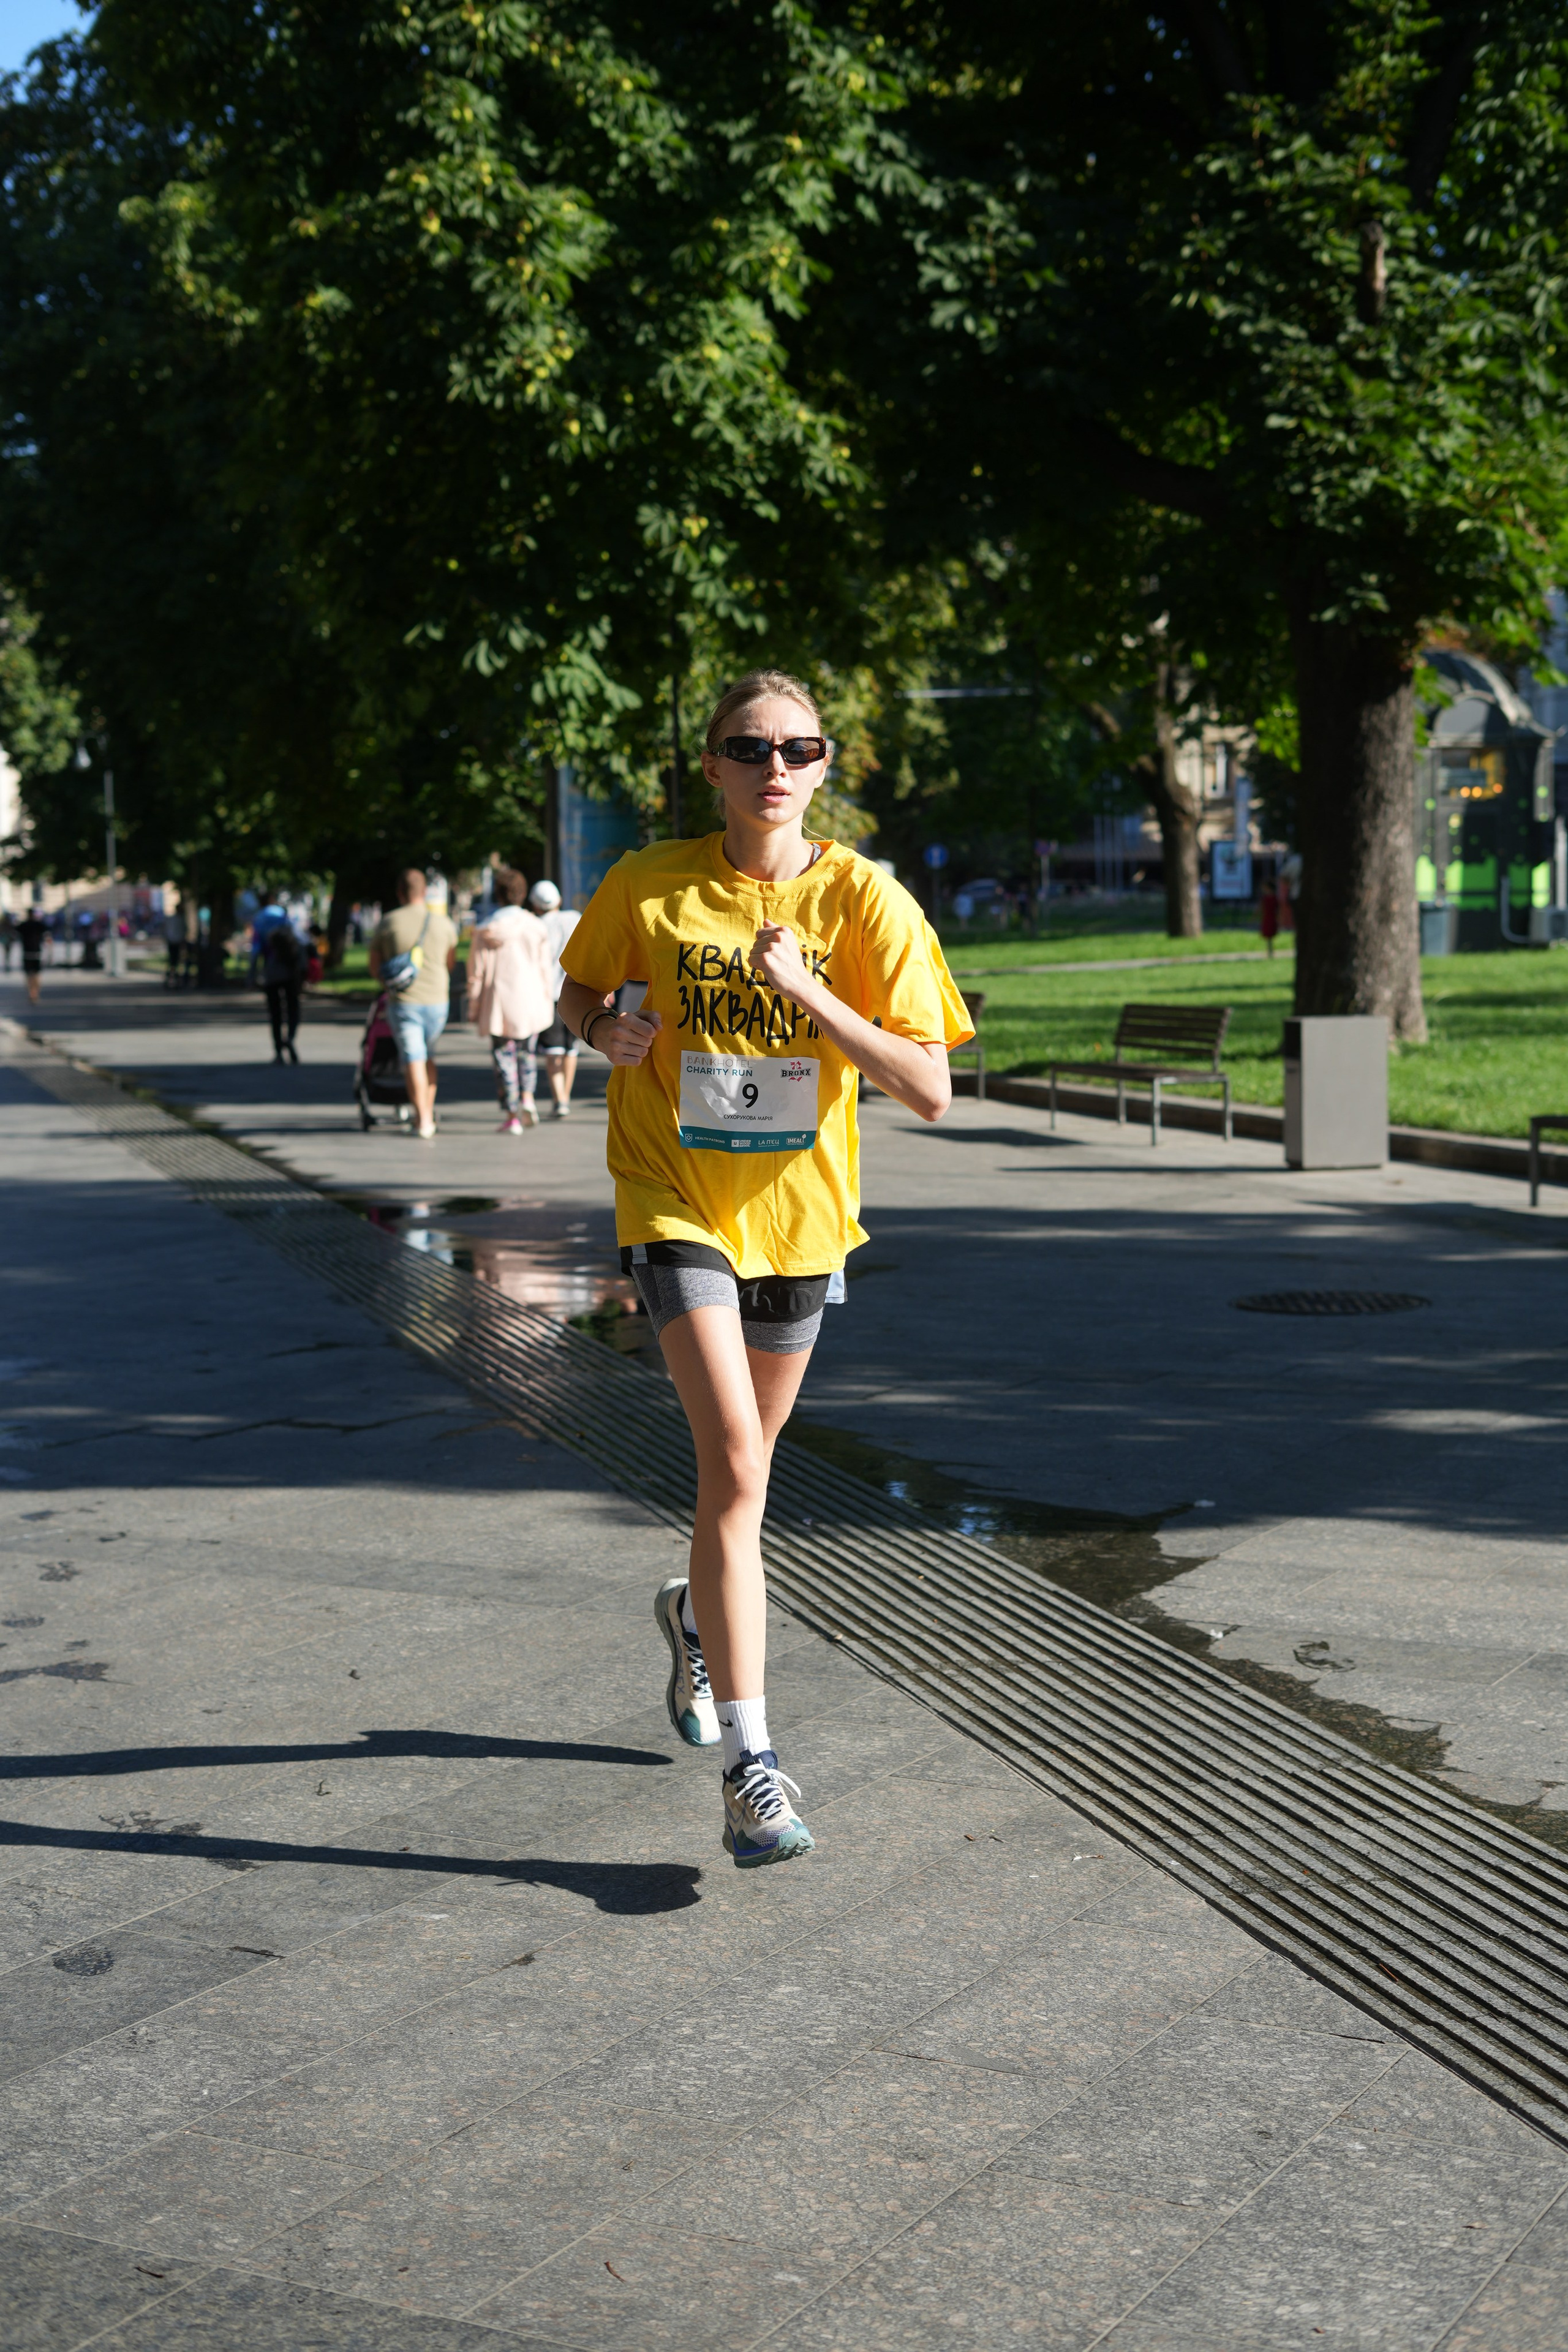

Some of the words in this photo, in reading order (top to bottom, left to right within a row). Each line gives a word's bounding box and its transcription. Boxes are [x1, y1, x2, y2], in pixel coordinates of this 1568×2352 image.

[687, 1055, 753, 1068] BANKHOTEL
[686, 1066, 729, 1076] CHARITY
[781, 1068, 810, 1077] BRONX
[742, 1083, 759, 1109] 9
